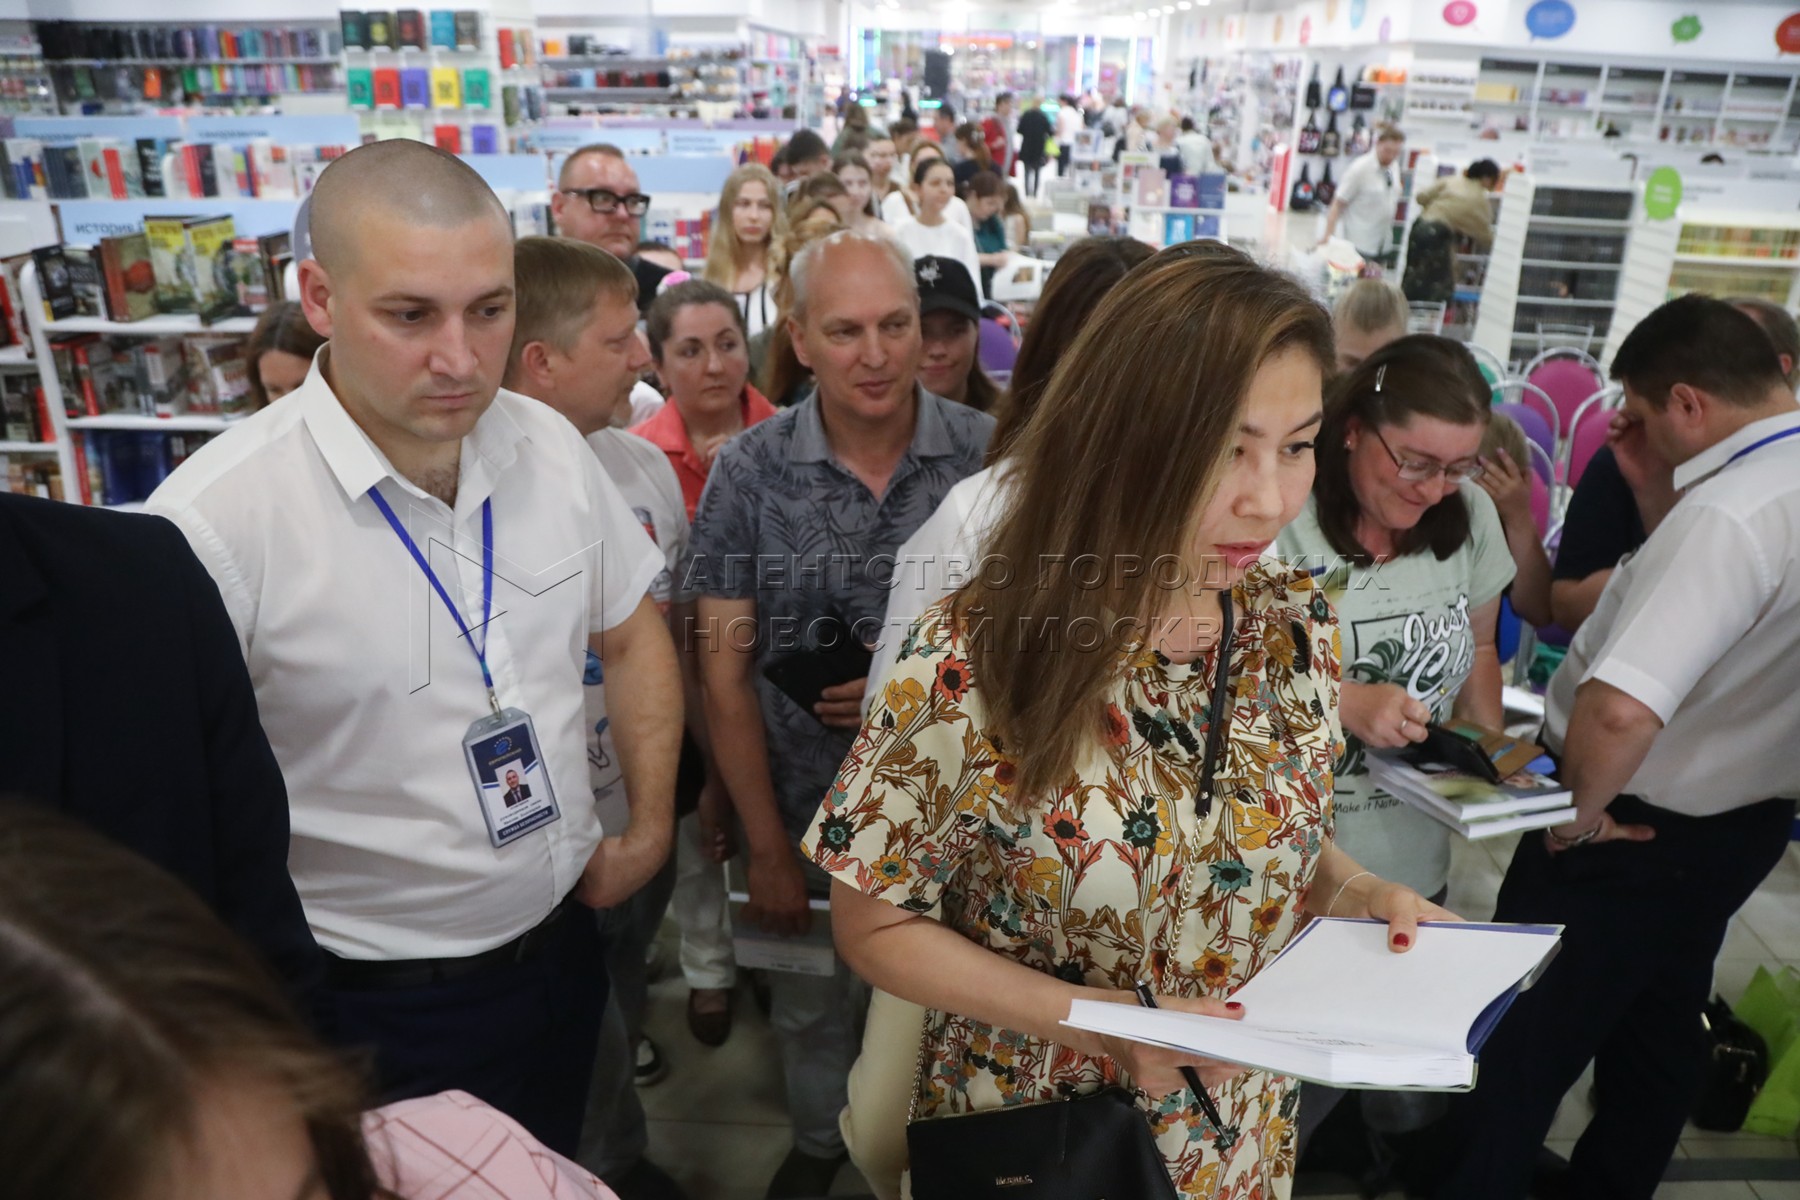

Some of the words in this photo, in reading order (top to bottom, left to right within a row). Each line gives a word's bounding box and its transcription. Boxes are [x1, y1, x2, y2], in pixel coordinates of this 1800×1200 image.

[1402, 593, 1470, 673] Just
[1333, 802, 1361, 814] Make
[1363, 802, 1372, 811] it
